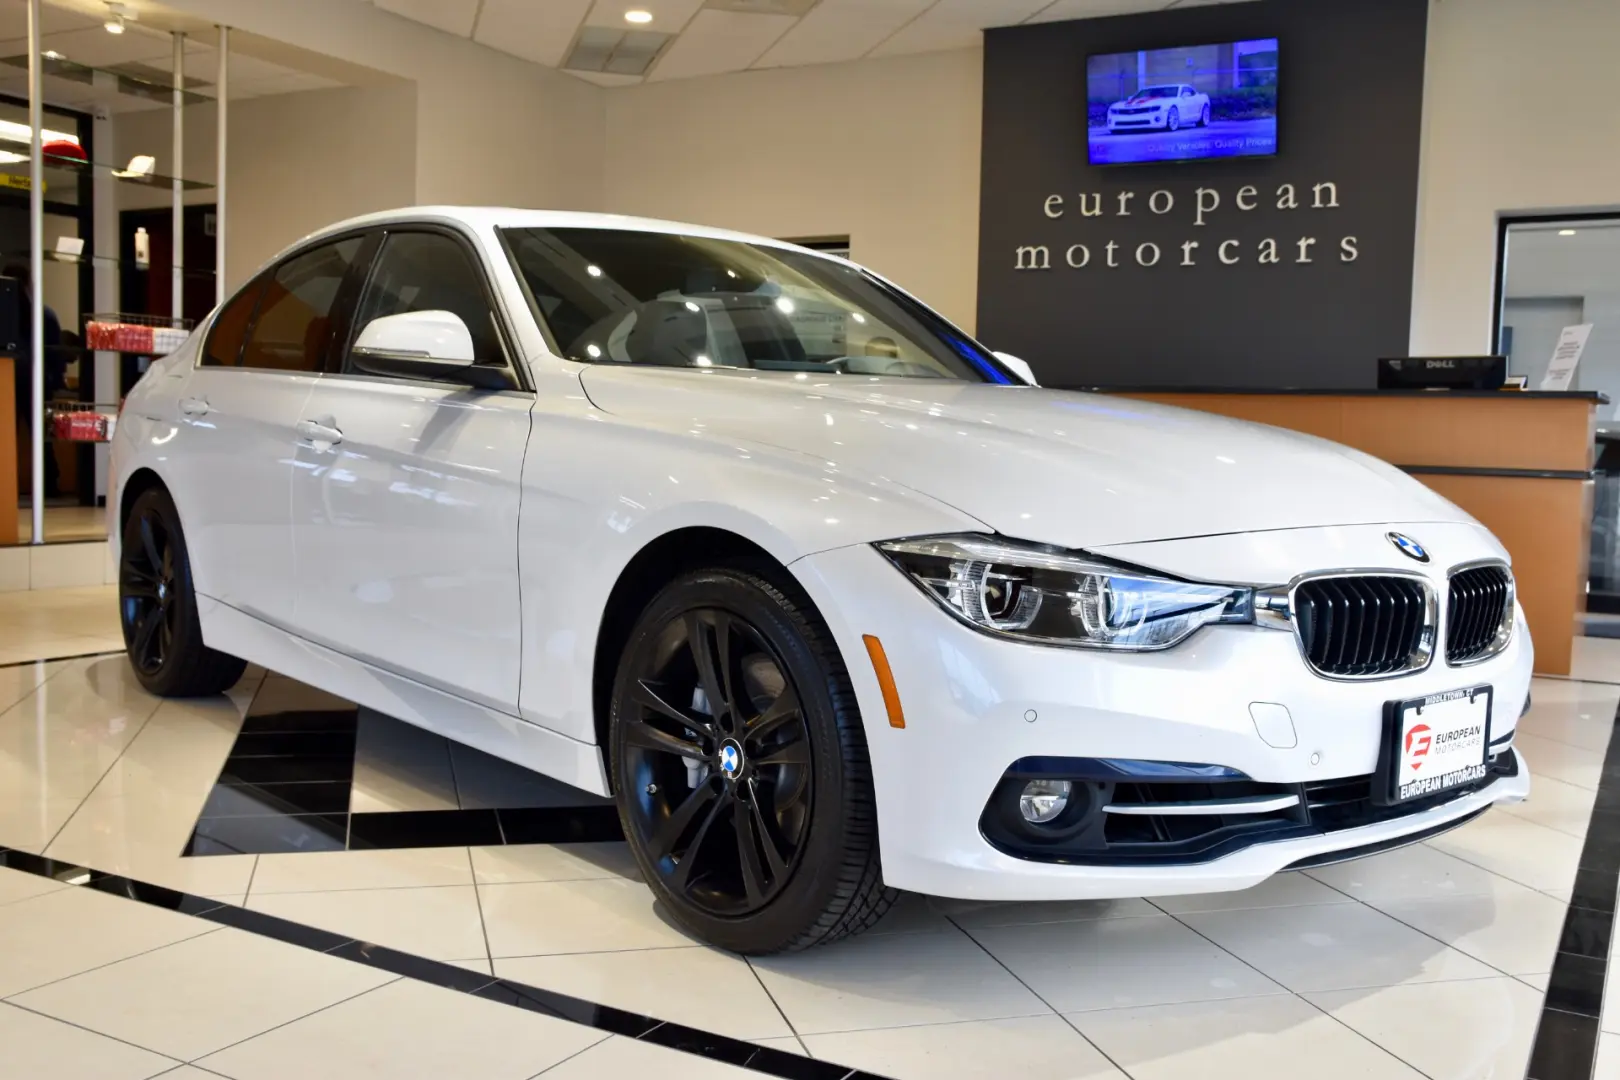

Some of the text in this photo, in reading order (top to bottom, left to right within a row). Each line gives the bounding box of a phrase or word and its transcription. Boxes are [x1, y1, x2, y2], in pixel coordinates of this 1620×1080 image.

[1044, 180, 1339, 225] european
[1014, 235, 1358, 269] motorcars
[1426, 359, 1455, 368] DELL
[1435, 738, 1481, 755] MOTORCARS
[1436, 725, 1481, 744] EUROPEAN
[1400, 764, 1486, 799] EUROPEAN MOTORCARS
